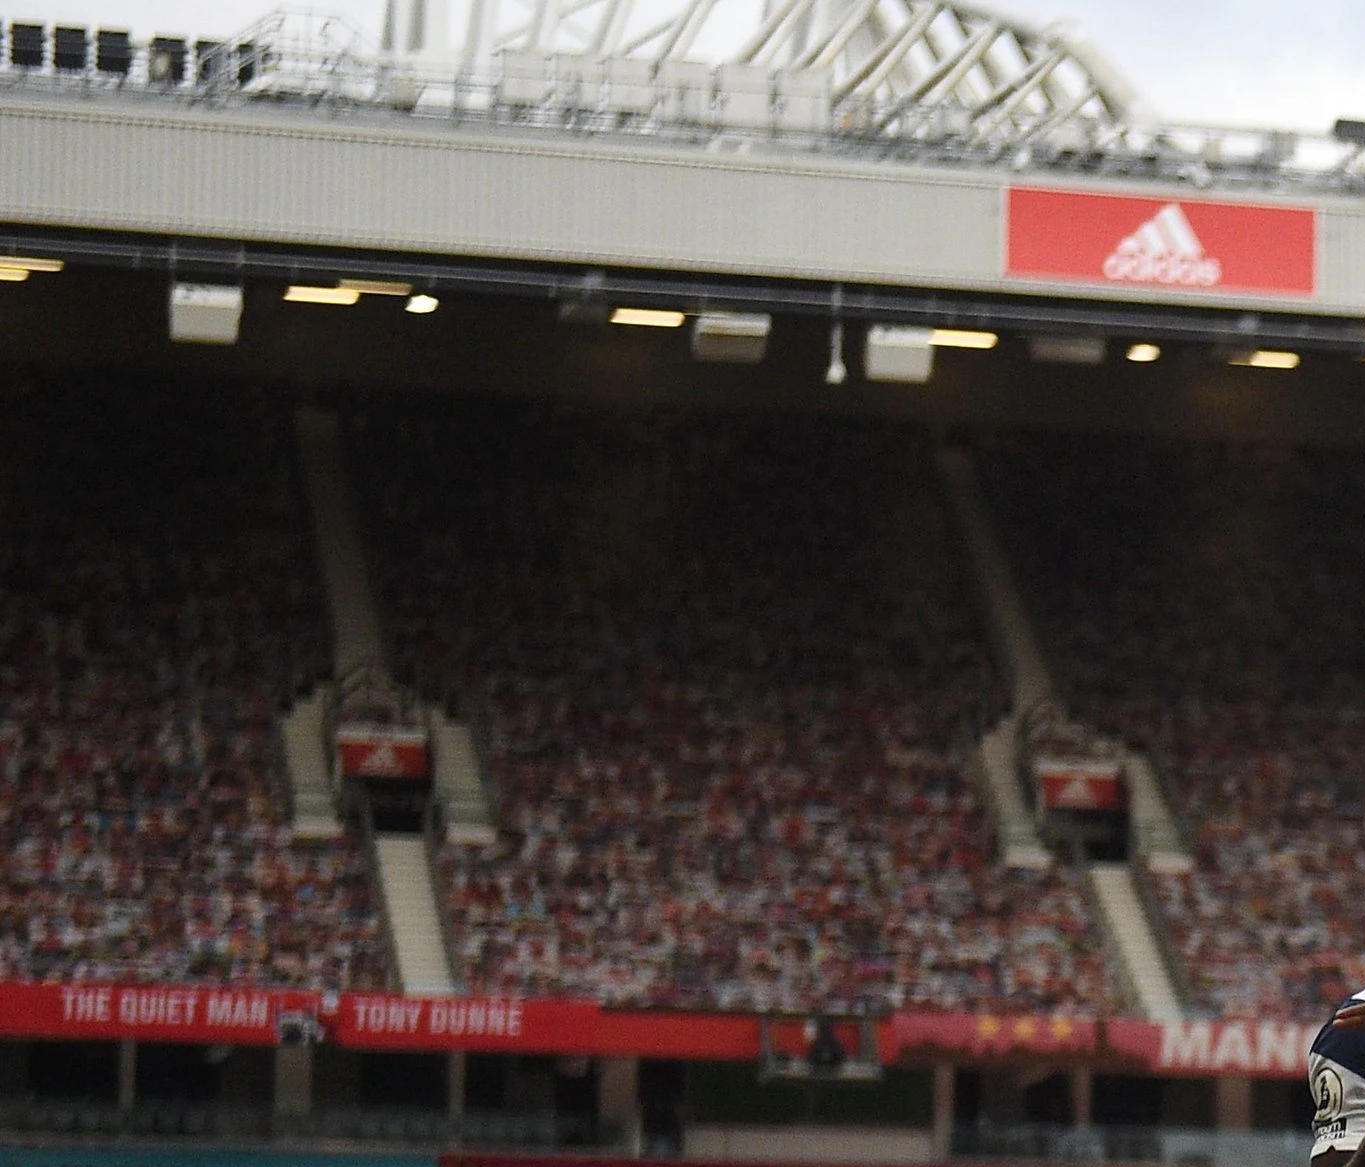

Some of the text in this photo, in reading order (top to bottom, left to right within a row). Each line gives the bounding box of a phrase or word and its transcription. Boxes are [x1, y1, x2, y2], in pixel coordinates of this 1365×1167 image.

[63, 986, 269, 1029] THE QUIET MAN
[353, 997, 523, 1037] TONY DUNNE
